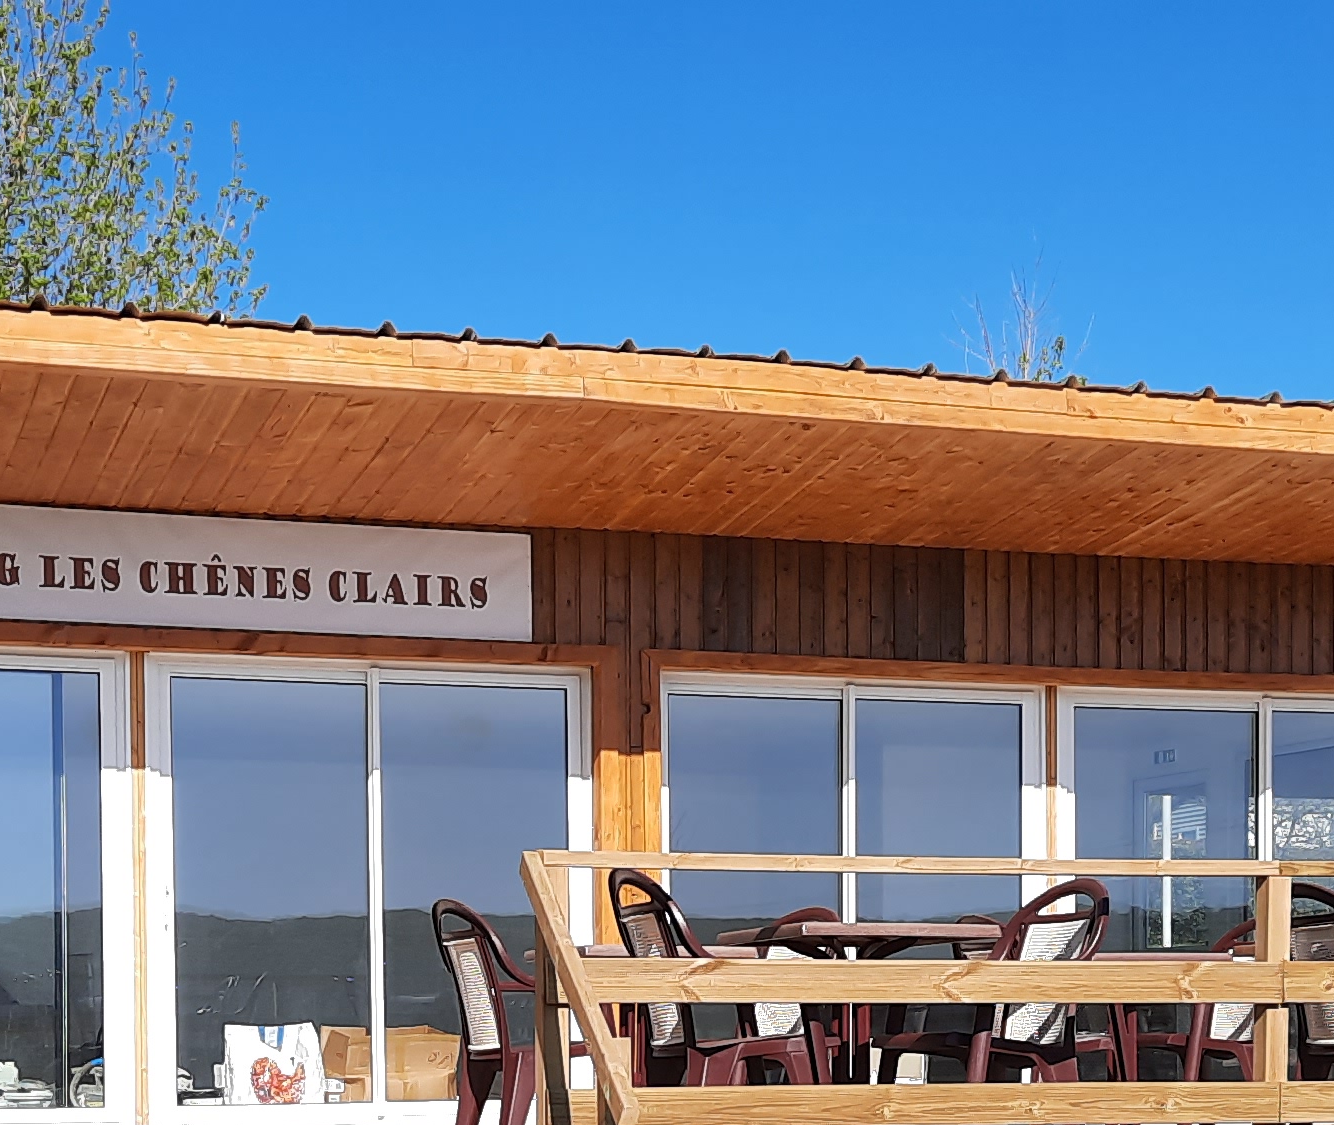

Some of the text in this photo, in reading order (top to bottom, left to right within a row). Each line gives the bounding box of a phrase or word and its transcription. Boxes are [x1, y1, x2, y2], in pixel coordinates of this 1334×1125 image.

[39, 554, 122, 593] LES
[138, 553, 313, 602] CHÊNES
[328, 570, 490, 610] CLAIRS
